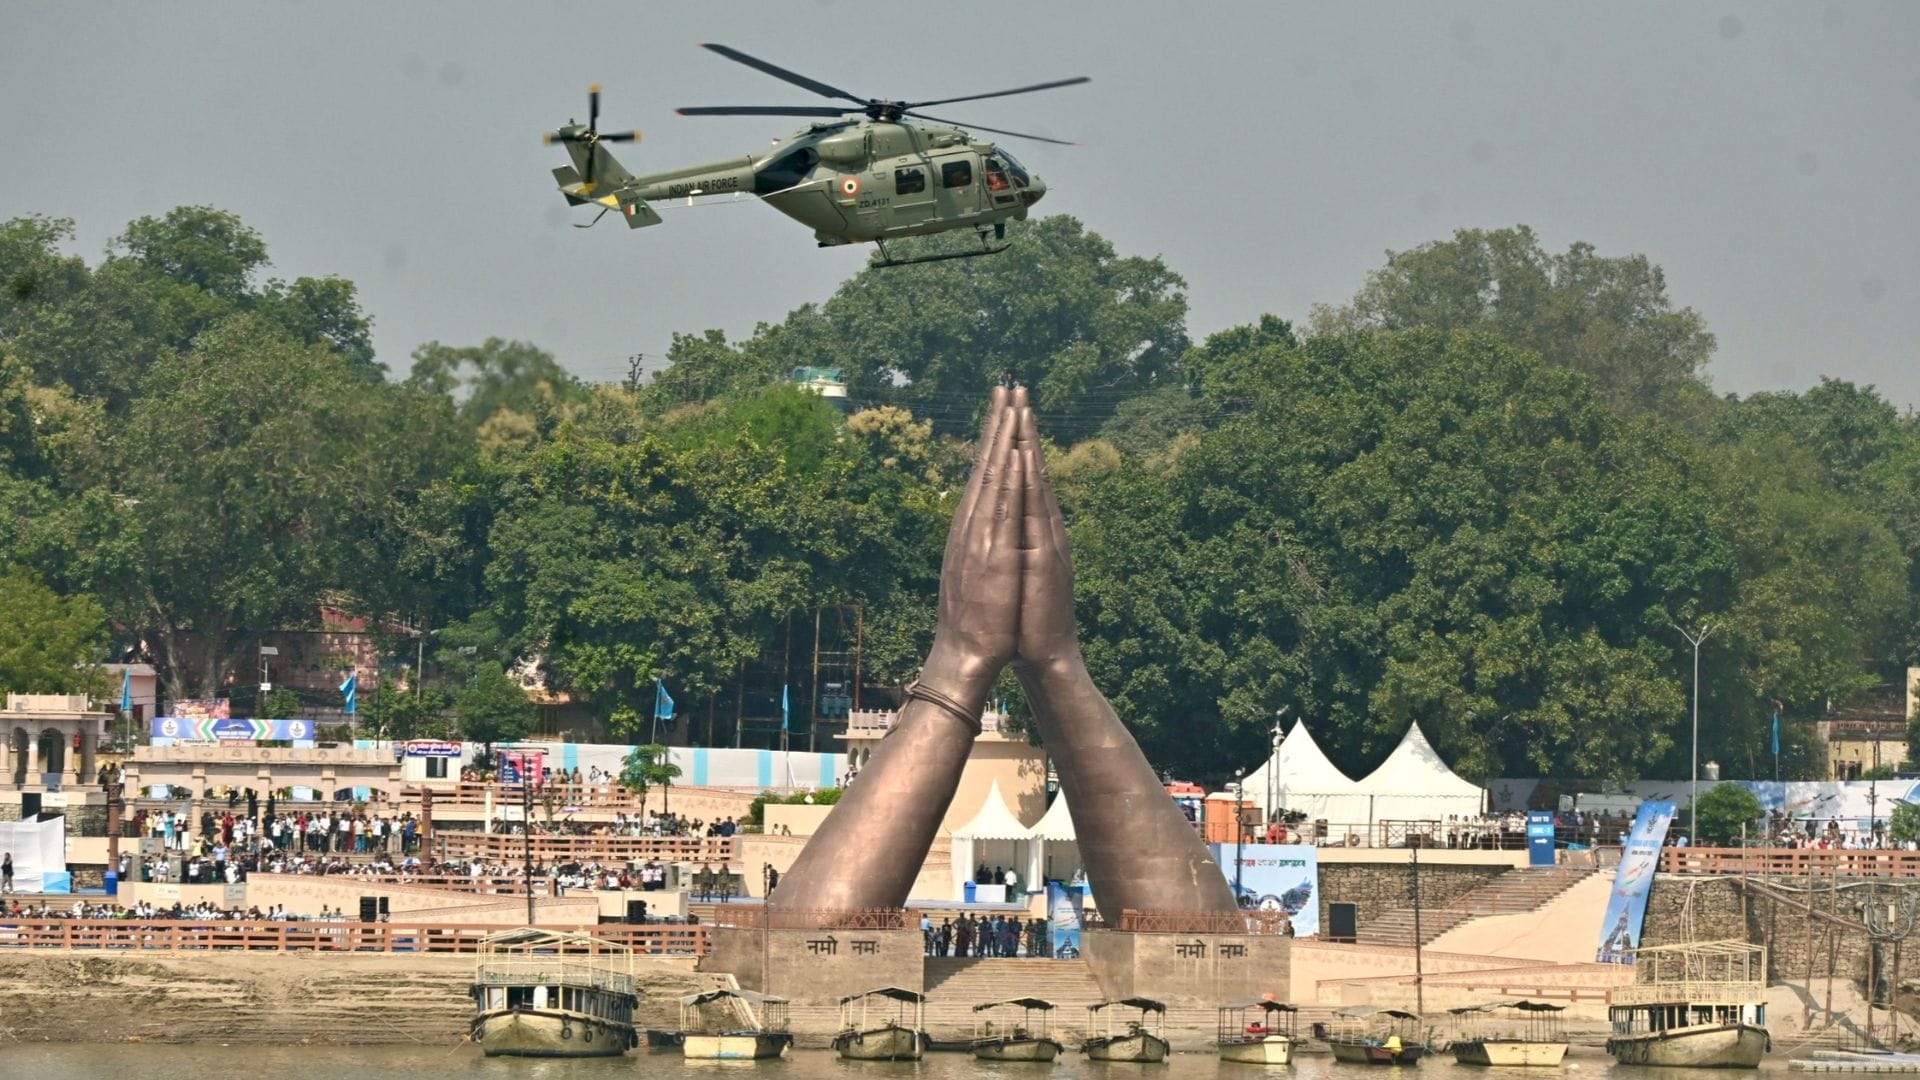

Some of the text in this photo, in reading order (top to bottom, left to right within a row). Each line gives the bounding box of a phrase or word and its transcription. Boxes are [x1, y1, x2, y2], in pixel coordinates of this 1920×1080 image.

[668, 176, 739, 197] INDIAN AIR FORCE
[806, 935, 880, 955] नमो नमः
[1175, 939, 1248, 959] नमो नमः
